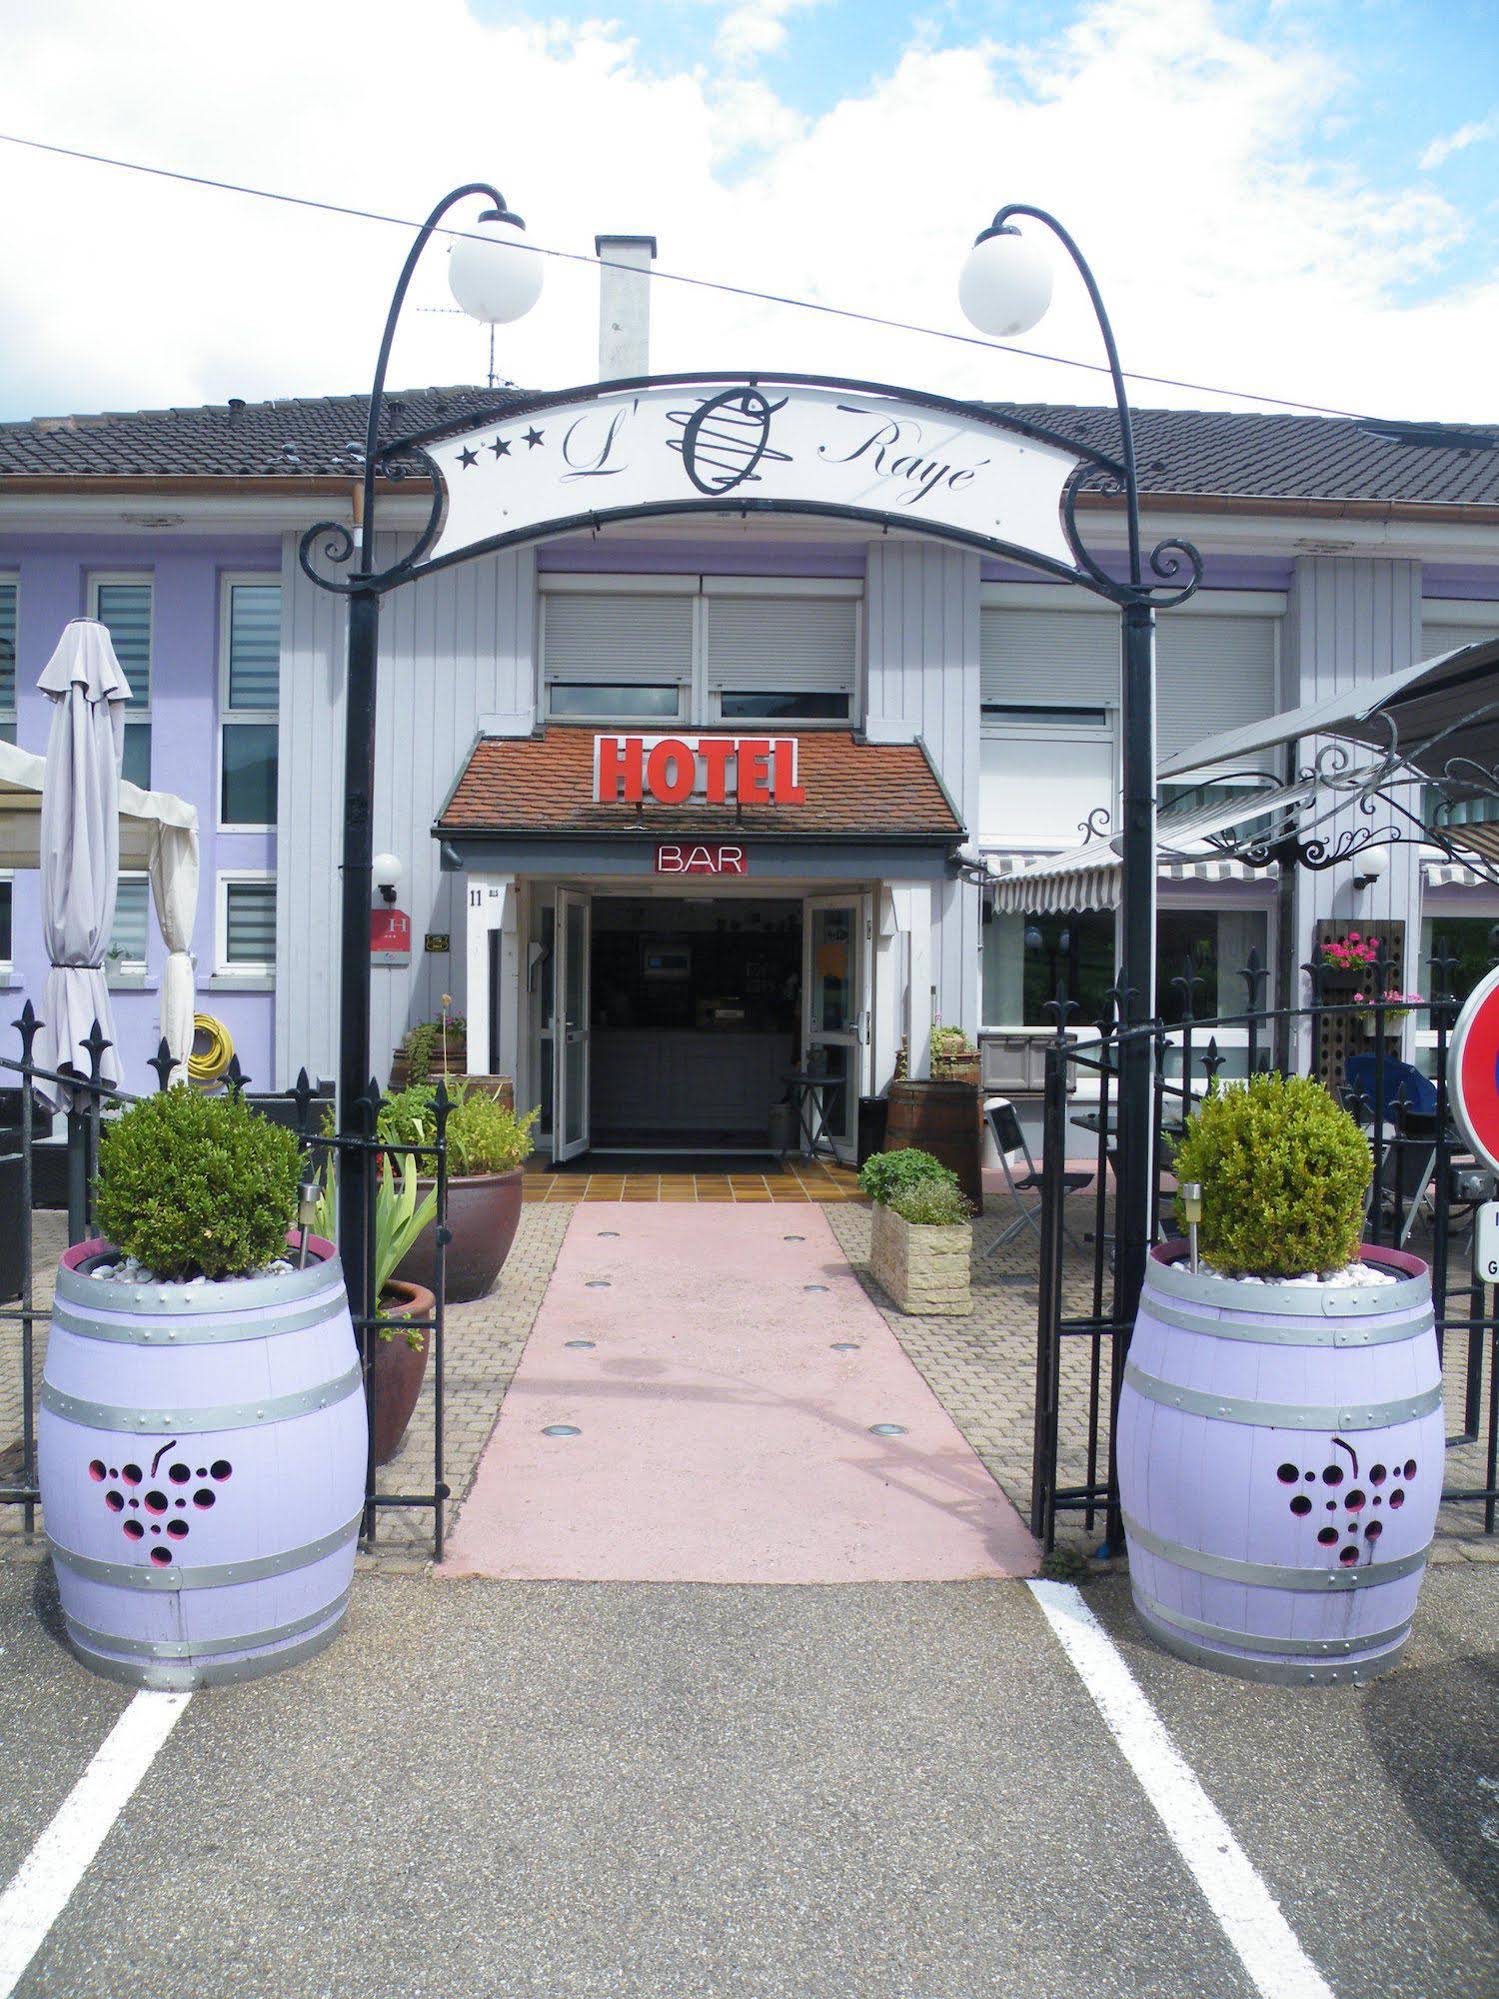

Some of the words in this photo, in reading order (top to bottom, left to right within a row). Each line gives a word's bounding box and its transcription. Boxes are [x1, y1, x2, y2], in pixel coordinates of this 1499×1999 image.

[817, 404, 991, 506] Rayé
[599, 738, 806, 804] HOTEL
[658, 845, 743, 873] BAR
